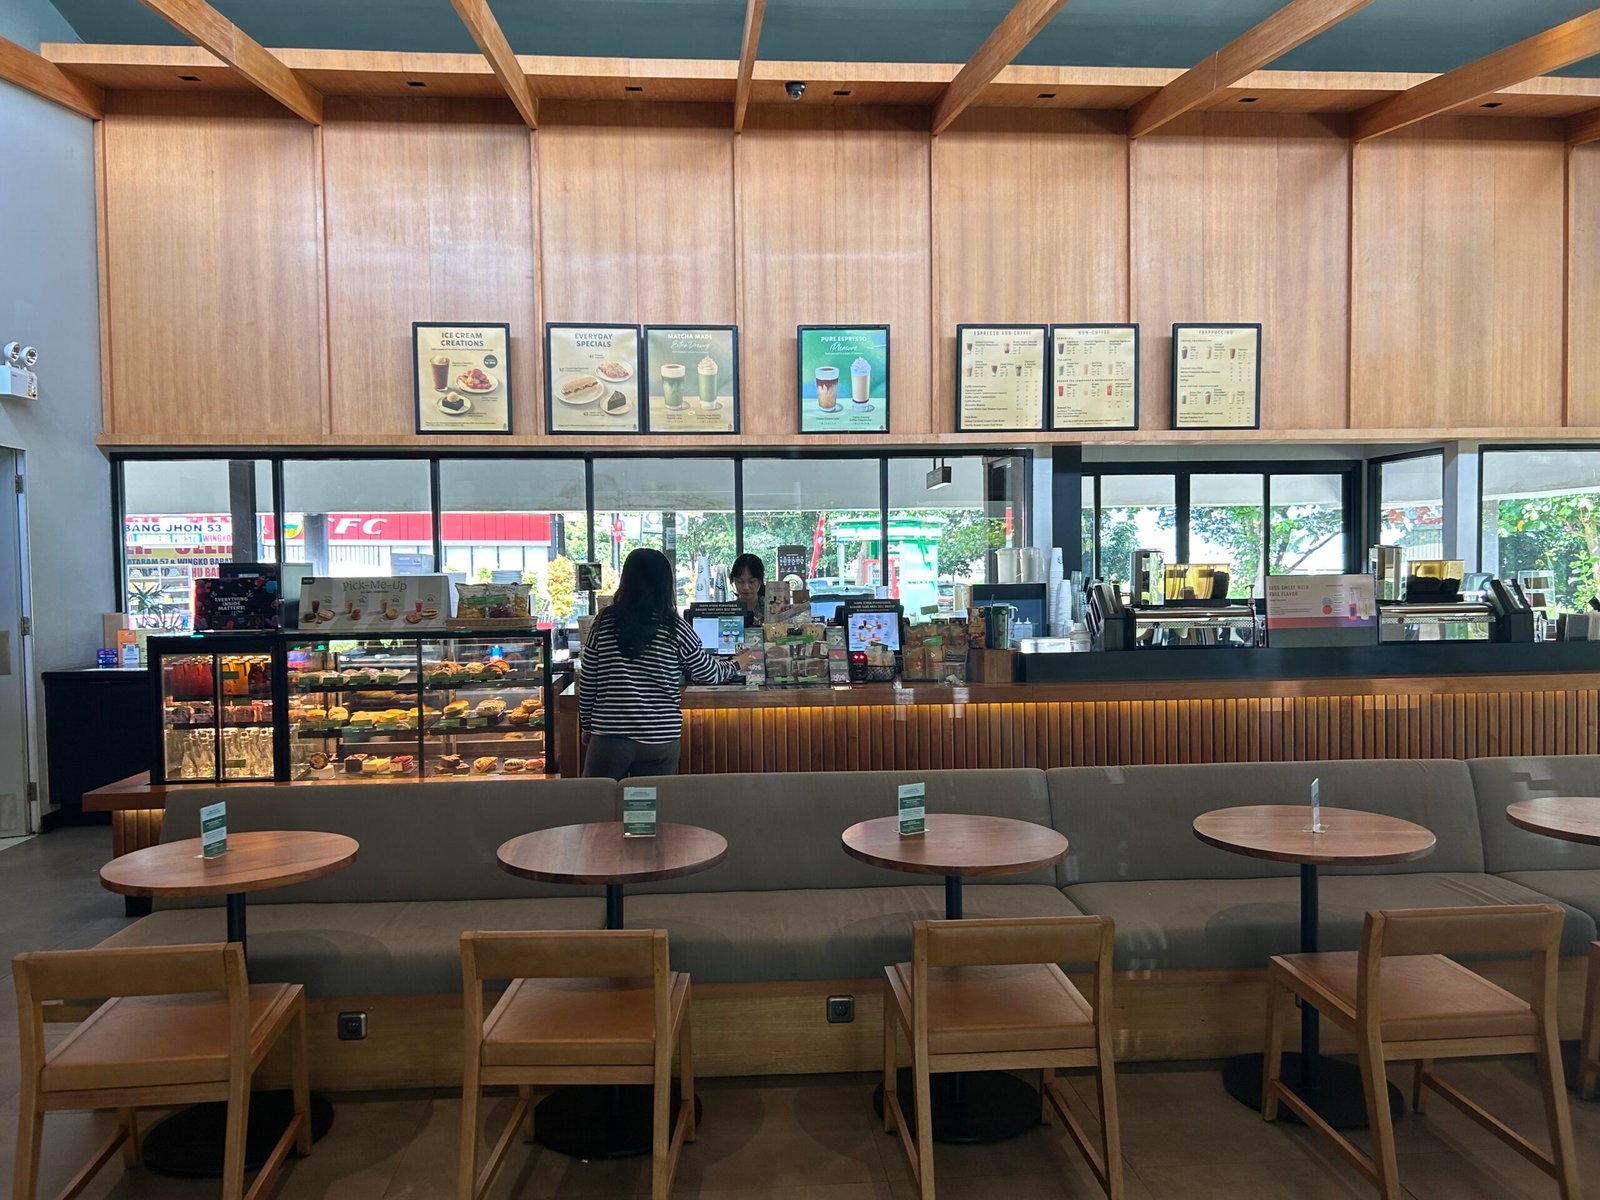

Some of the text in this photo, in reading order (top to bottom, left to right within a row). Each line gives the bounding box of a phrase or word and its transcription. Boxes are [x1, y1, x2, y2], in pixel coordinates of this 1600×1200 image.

[575, 332, 613, 340] EVERYDAY
[576, 340, 612, 348] SPECIALS
[165, 524, 202, 532] JHON
[207, 524, 222, 532] 53
[328, 518, 388, 535] FC
[343, 579, 407, 593] Pick-Me-Up
